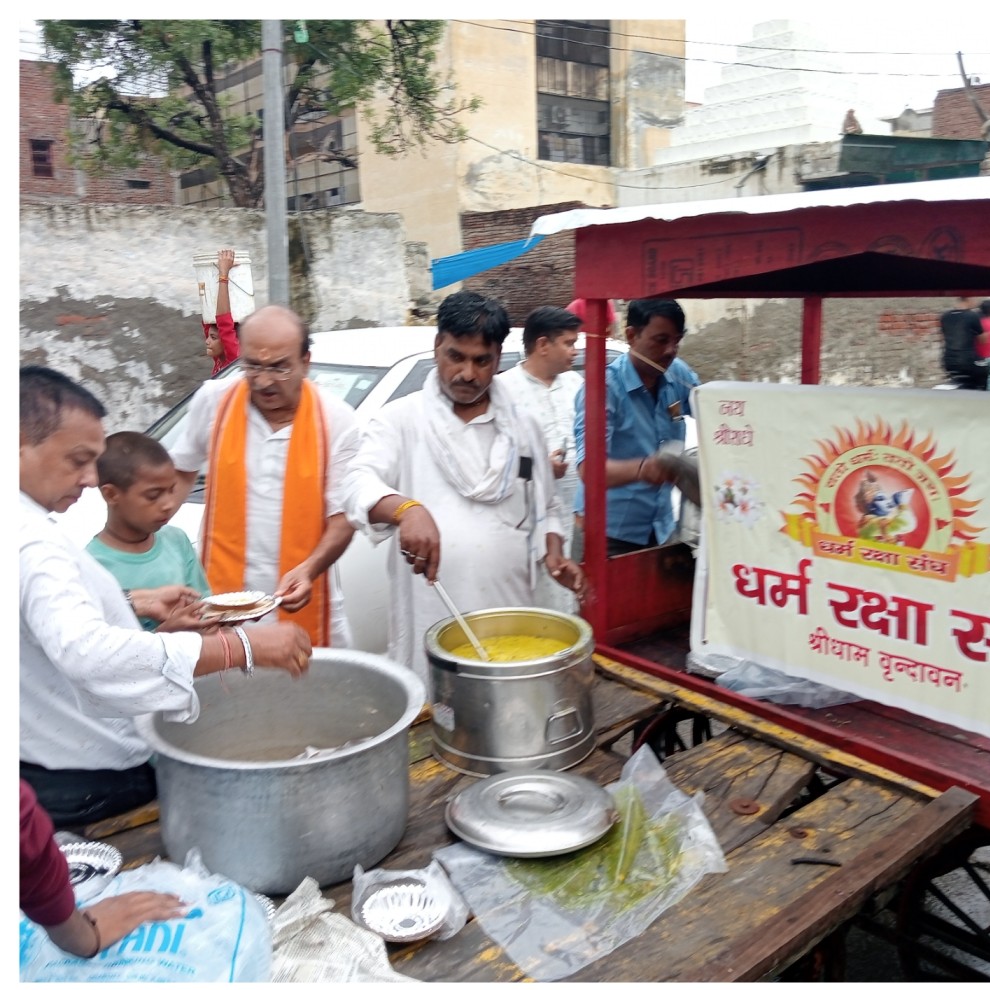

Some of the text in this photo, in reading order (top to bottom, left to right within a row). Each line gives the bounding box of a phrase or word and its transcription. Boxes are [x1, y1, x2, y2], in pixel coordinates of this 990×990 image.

[819, 540, 950, 575] धर्म रक्षा संघ
[732, 558, 813, 615] धर्म
[827, 582, 935, 646] रक्षा
[808, 627, 963, 692] श्रीधाम वृन्दावन
